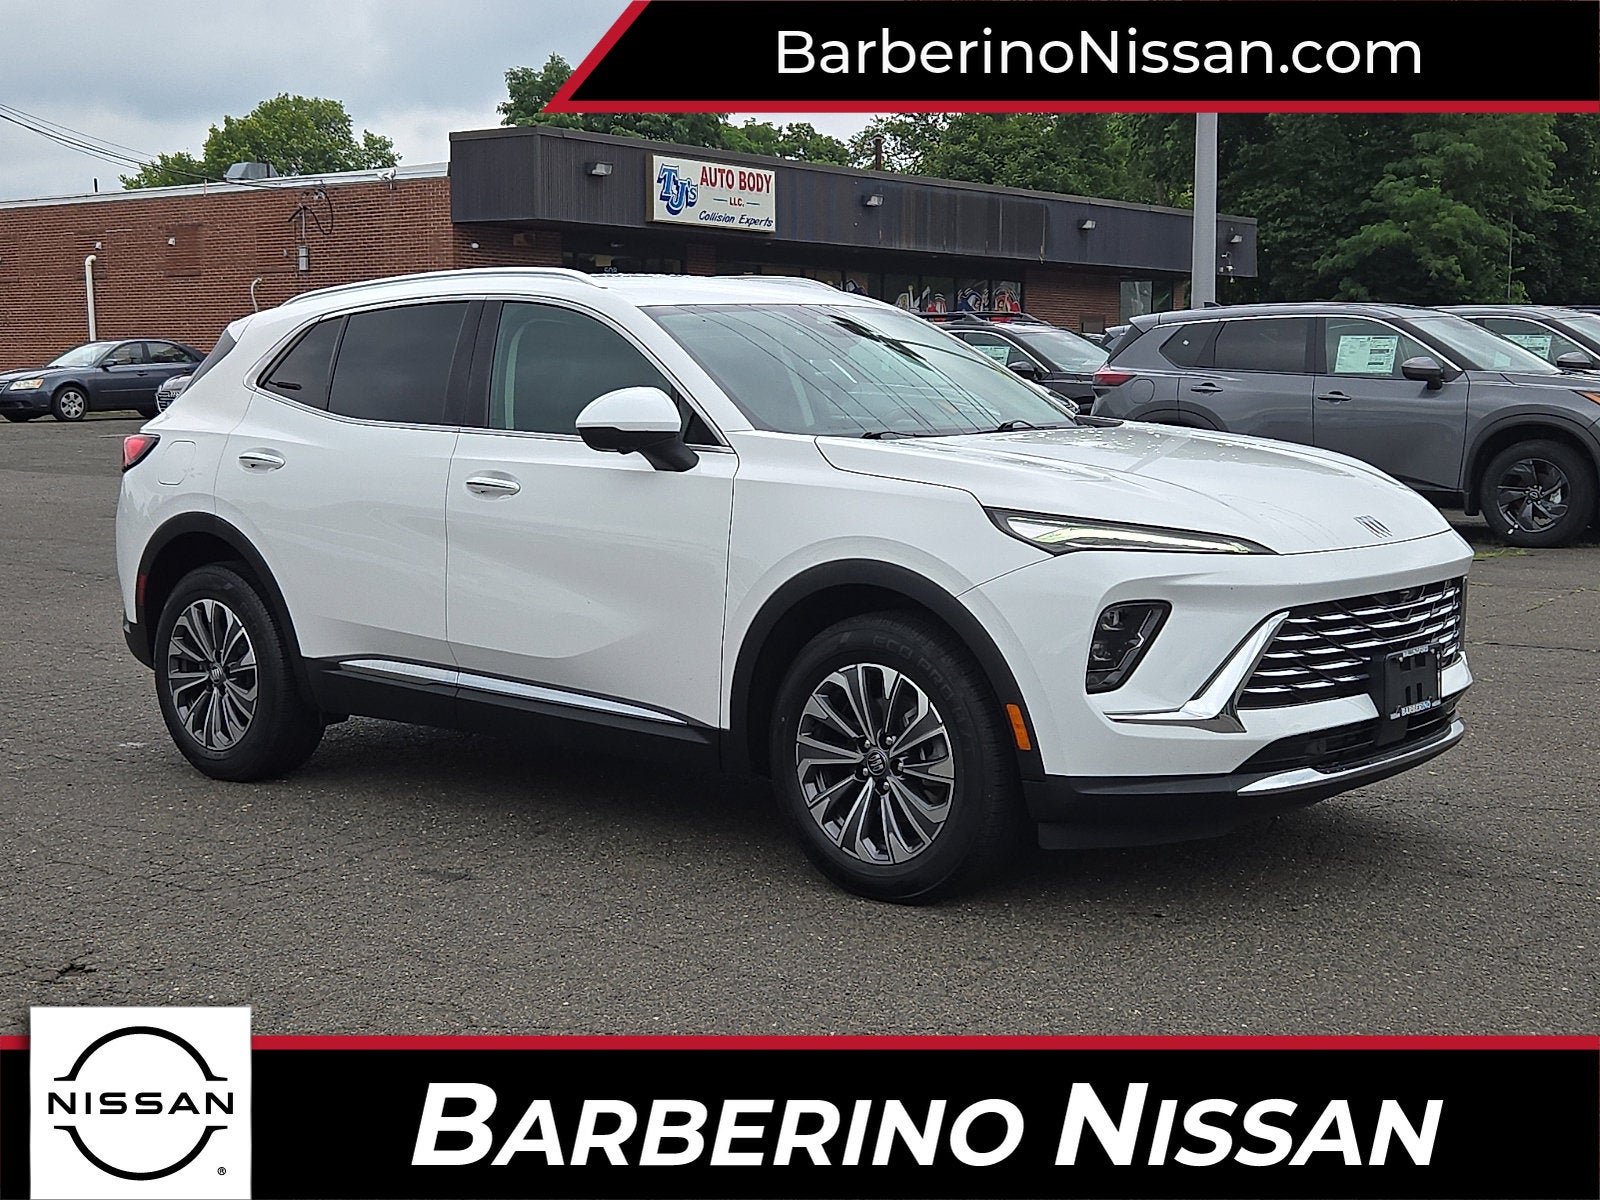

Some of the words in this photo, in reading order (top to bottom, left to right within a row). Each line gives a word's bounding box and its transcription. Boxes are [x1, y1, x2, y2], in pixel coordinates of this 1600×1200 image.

[700, 166, 735, 190] AUTO
[738, 170, 773, 194] BODY
[698, 210, 736, 224] Collision
[738, 214, 774, 228] Experts
